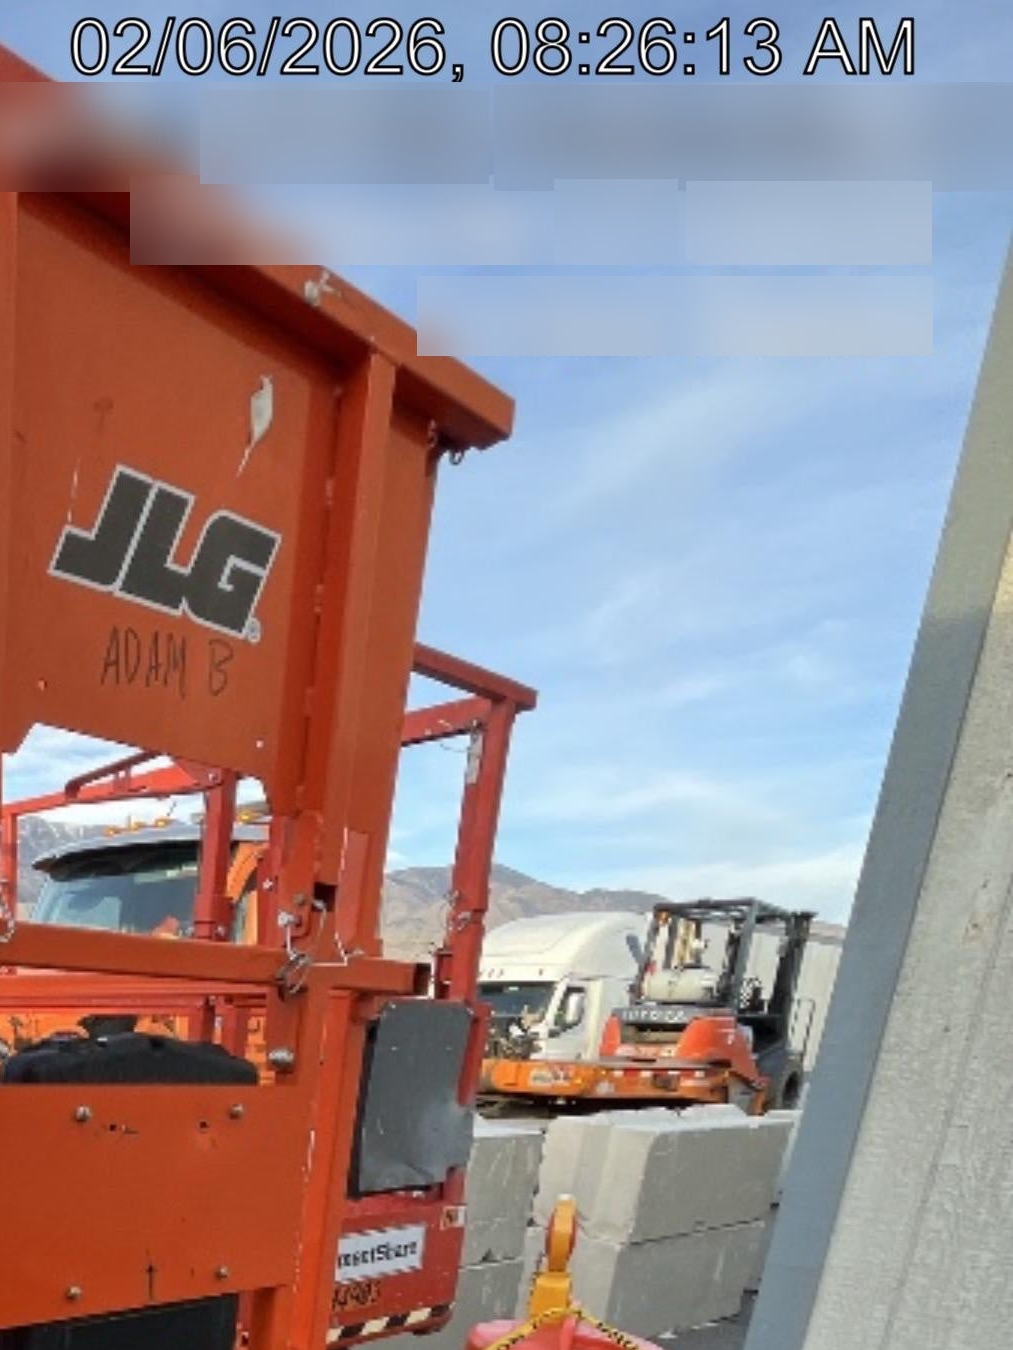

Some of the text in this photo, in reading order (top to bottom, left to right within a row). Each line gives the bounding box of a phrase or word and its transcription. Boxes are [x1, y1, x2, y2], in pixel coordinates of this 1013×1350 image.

[47, 463, 281, 640] JLG
[100, 625, 235, 699] ADAM B
